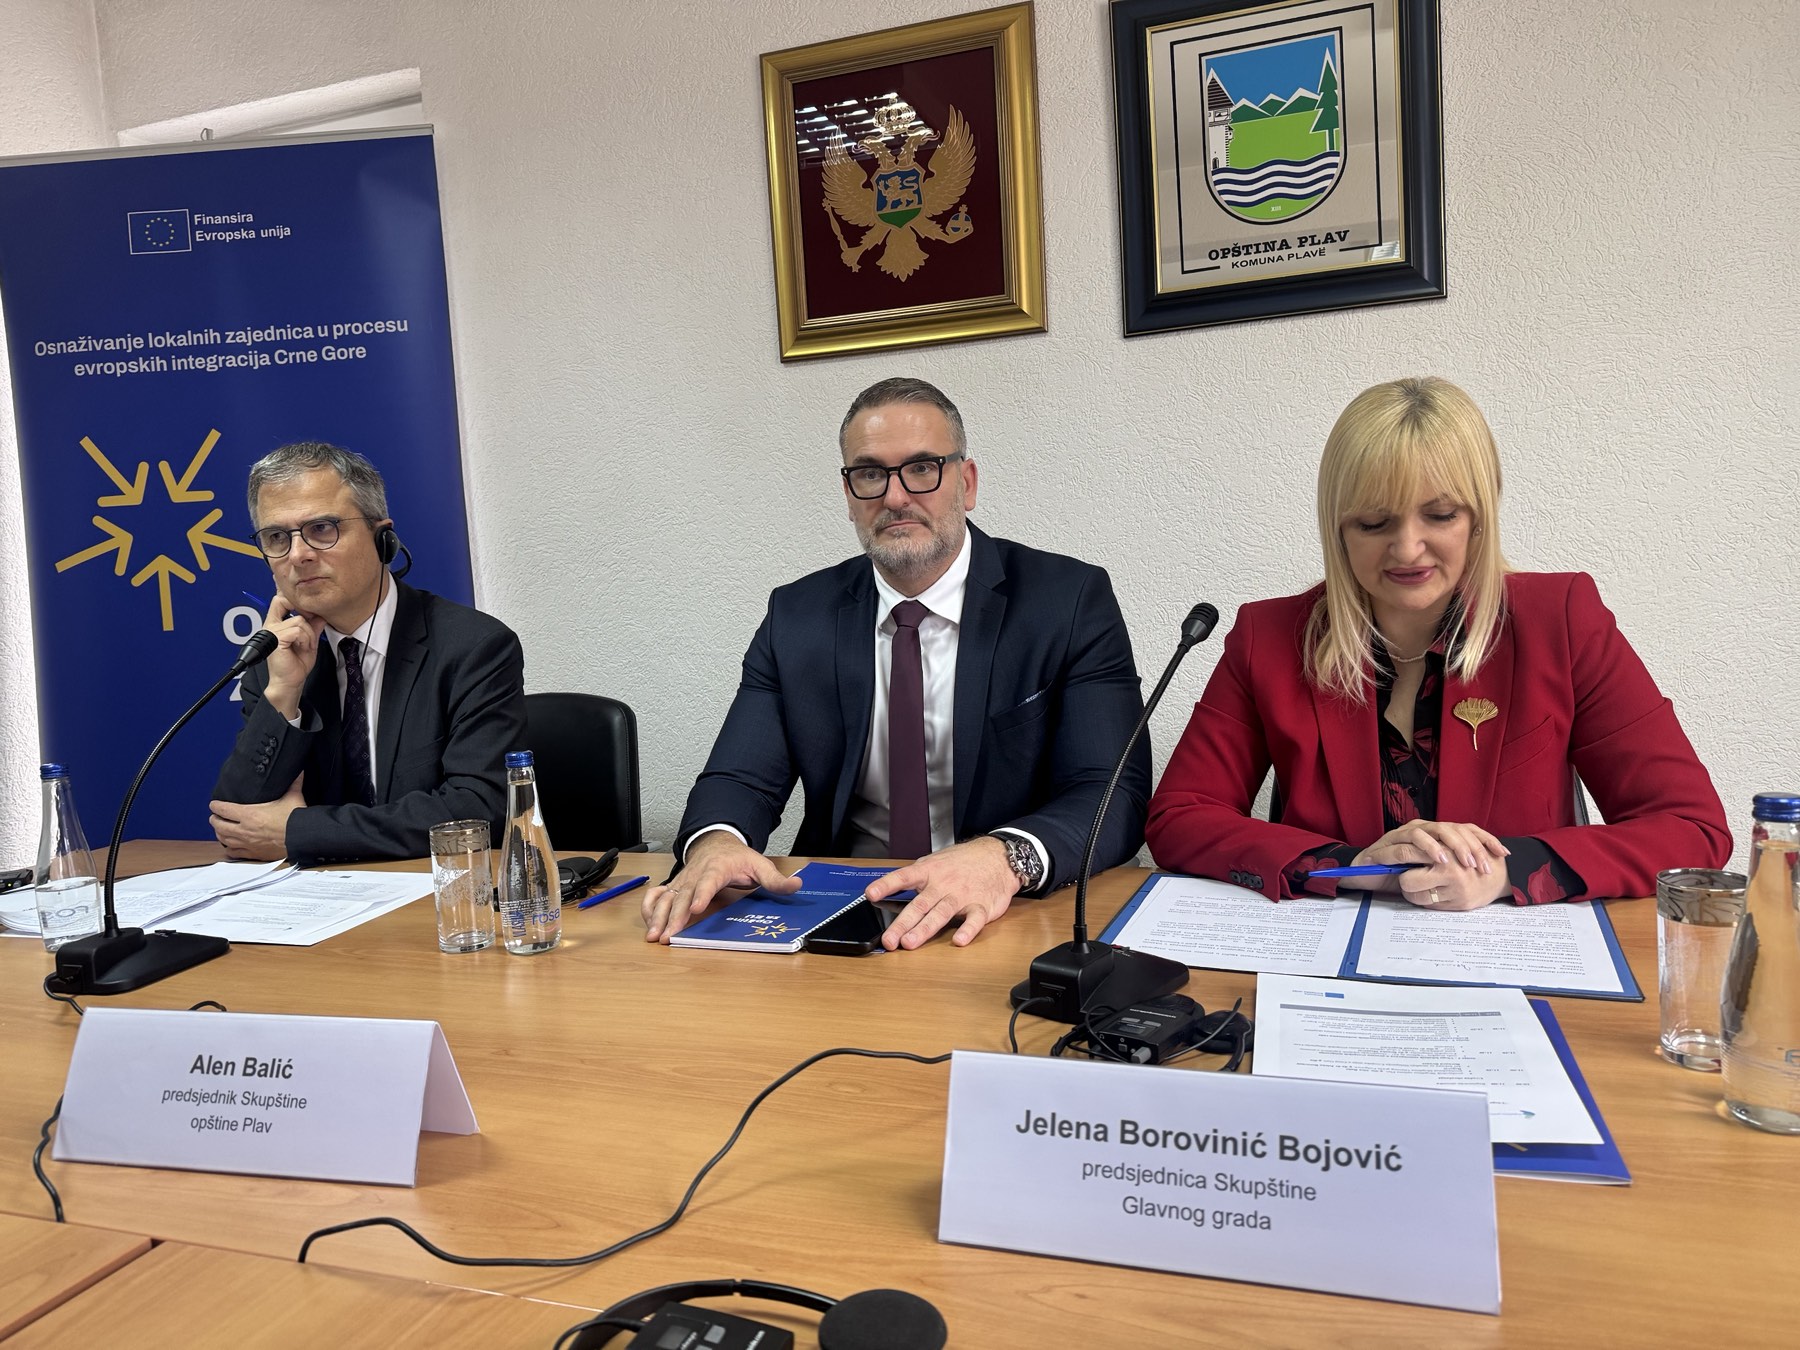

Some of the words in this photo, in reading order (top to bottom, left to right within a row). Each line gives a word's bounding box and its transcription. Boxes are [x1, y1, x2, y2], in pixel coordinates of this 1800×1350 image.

[194, 212, 254, 225] Finansira
[195, 228, 256, 242] Evropska
[260, 225, 291, 239] unija
[1208, 238, 1292, 261] OPŠTINA
[1297, 229, 1350, 248] PLAV
[1231, 254, 1285, 269] KOMUNA
[1287, 247, 1326, 261] PLAVË
[34, 333, 144, 357] Osnaživanje
[148, 328, 221, 348] lokalnih
[225, 323, 314, 346] zajednica
[317, 325, 329, 338] u
[333, 319, 408, 340] procesu
[73, 356, 168, 377] evropskih
[171, 350, 271, 372] integracija
[274, 349, 318, 365] Crne
[321, 345, 367, 361] Gore
[532, 908, 560, 925] rosa
[189, 1054, 236, 1076] Alen
[242, 1056, 294, 1080] Balić
[161, 1087, 238, 1107] predsjednik
[241, 1090, 308, 1110] Skupštine
[190, 1115, 239, 1132] opštine
[242, 1117, 273, 1134] Plav
[1015, 1109, 1109, 1143] Jelena
[1119, 1119, 1267, 1159] Borovinić
[1278, 1134, 1403, 1172] Bojović
[1082, 1162, 1207, 1190] predsjednica
[1214, 1172, 1317, 1201] Skupštine
[1122, 1195, 1206, 1228] Glavnog
[1211, 1210, 1272, 1231] grada
